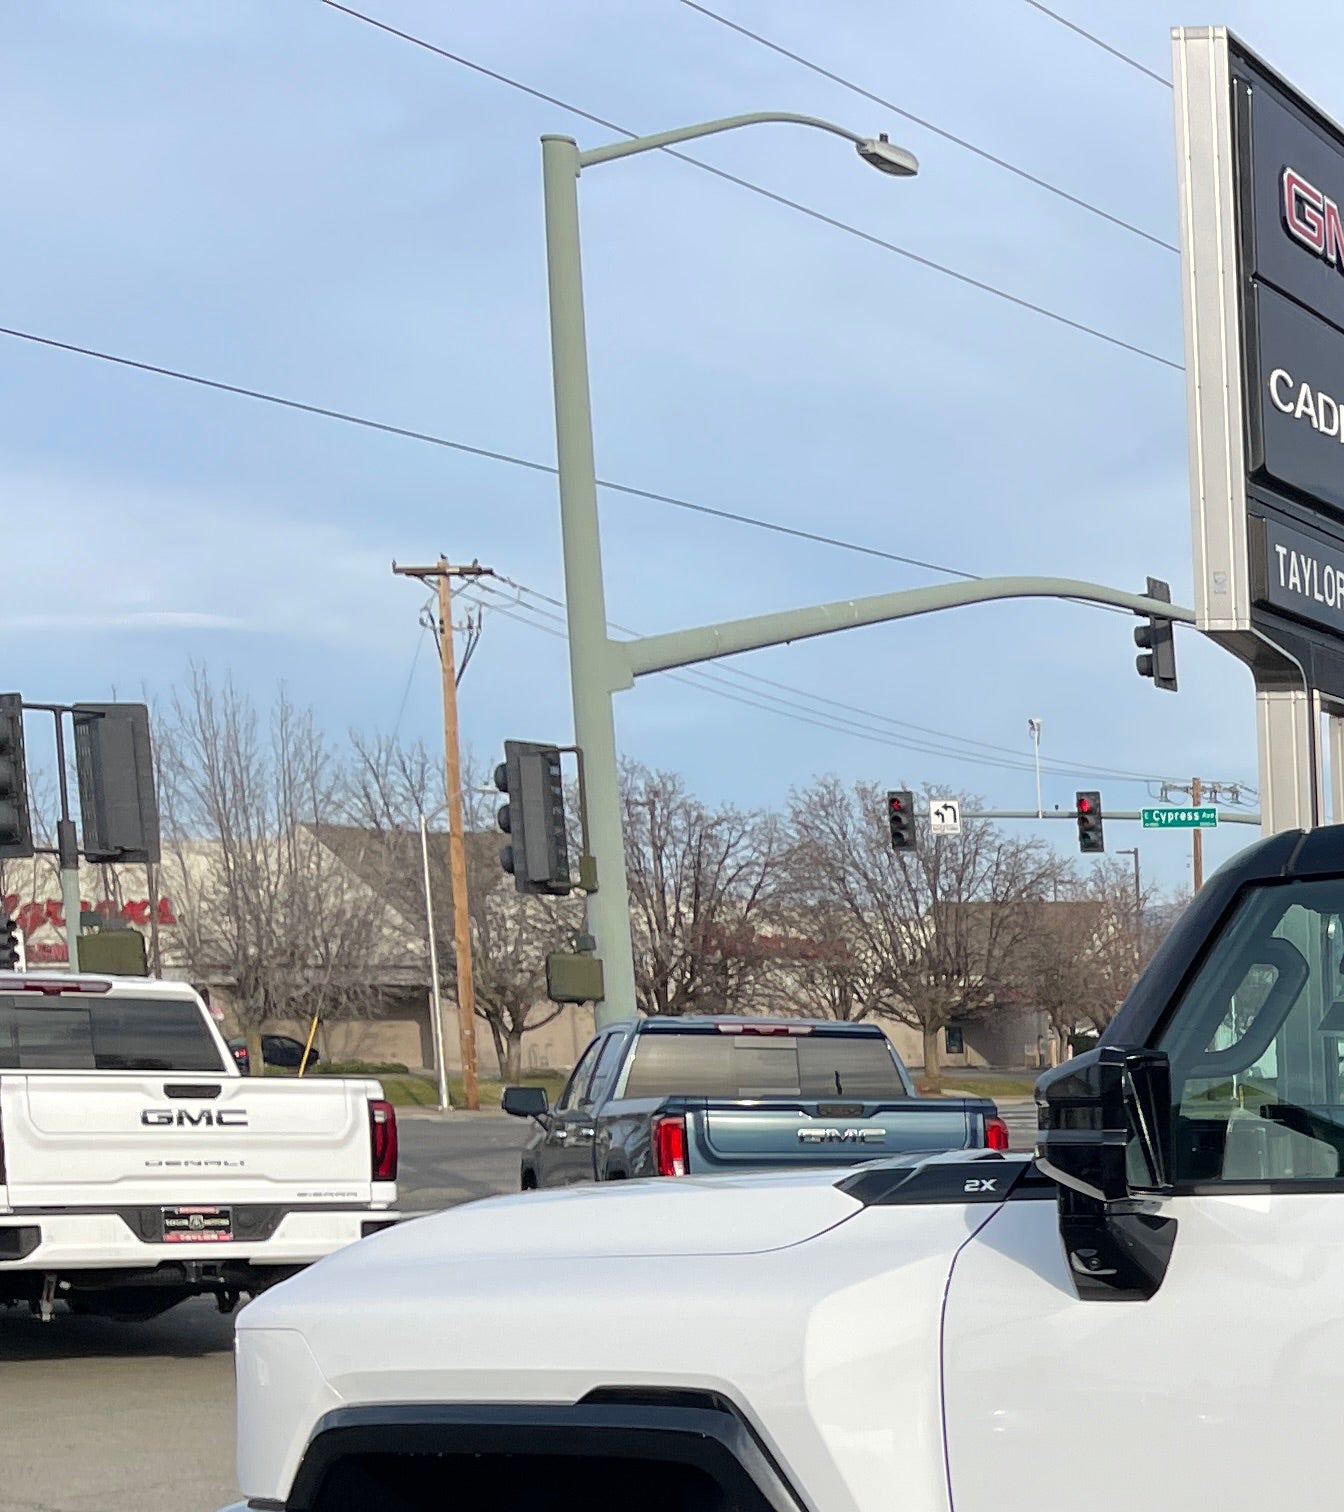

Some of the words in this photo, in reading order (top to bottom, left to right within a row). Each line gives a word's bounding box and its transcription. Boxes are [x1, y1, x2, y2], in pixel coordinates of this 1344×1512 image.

[1152, 810, 1200, 824] Cypress
[1202, 811, 1215, 819] Ave
[141, 1109, 248, 1126] GMC
[797, 1128, 886, 1144] GMC
[963, 1178, 997, 1192] 2X
